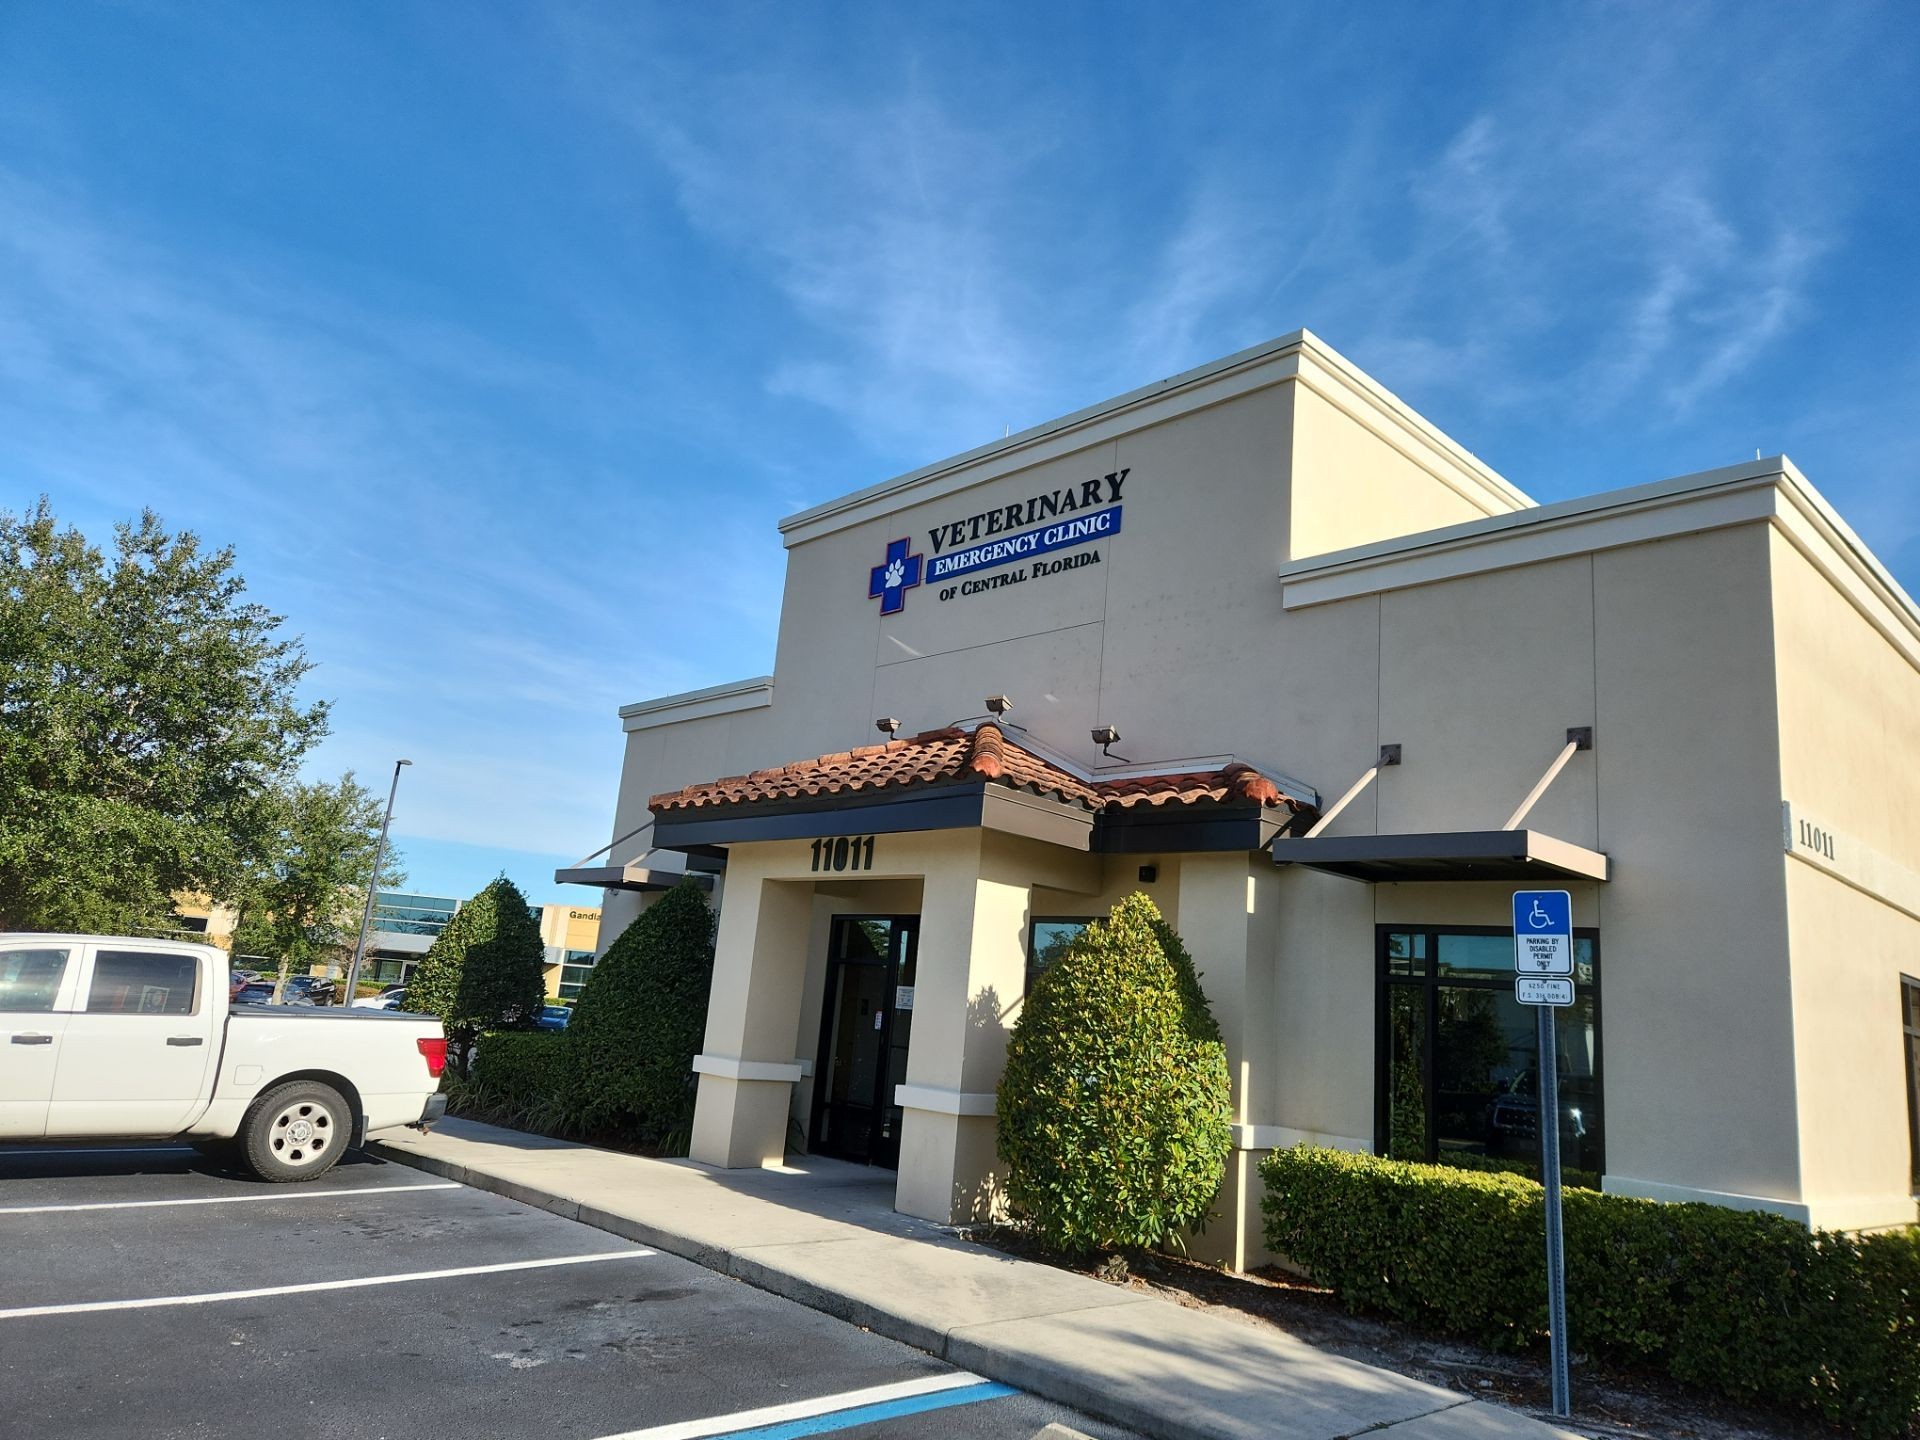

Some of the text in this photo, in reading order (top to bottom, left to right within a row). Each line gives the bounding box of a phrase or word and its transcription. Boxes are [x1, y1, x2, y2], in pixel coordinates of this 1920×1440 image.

[928, 468, 1131, 554] VETERINARY
[934, 512, 1111, 576] EMERGENCY CLINIC
[961, 567, 1027, 596] CENTRAL
[1032, 550, 1101, 579] FLORIDA
[810, 835, 875, 871] 11011
[1800, 819, 1835, 861] 11011
[1529, 945, 1557, 953] DISABLED
